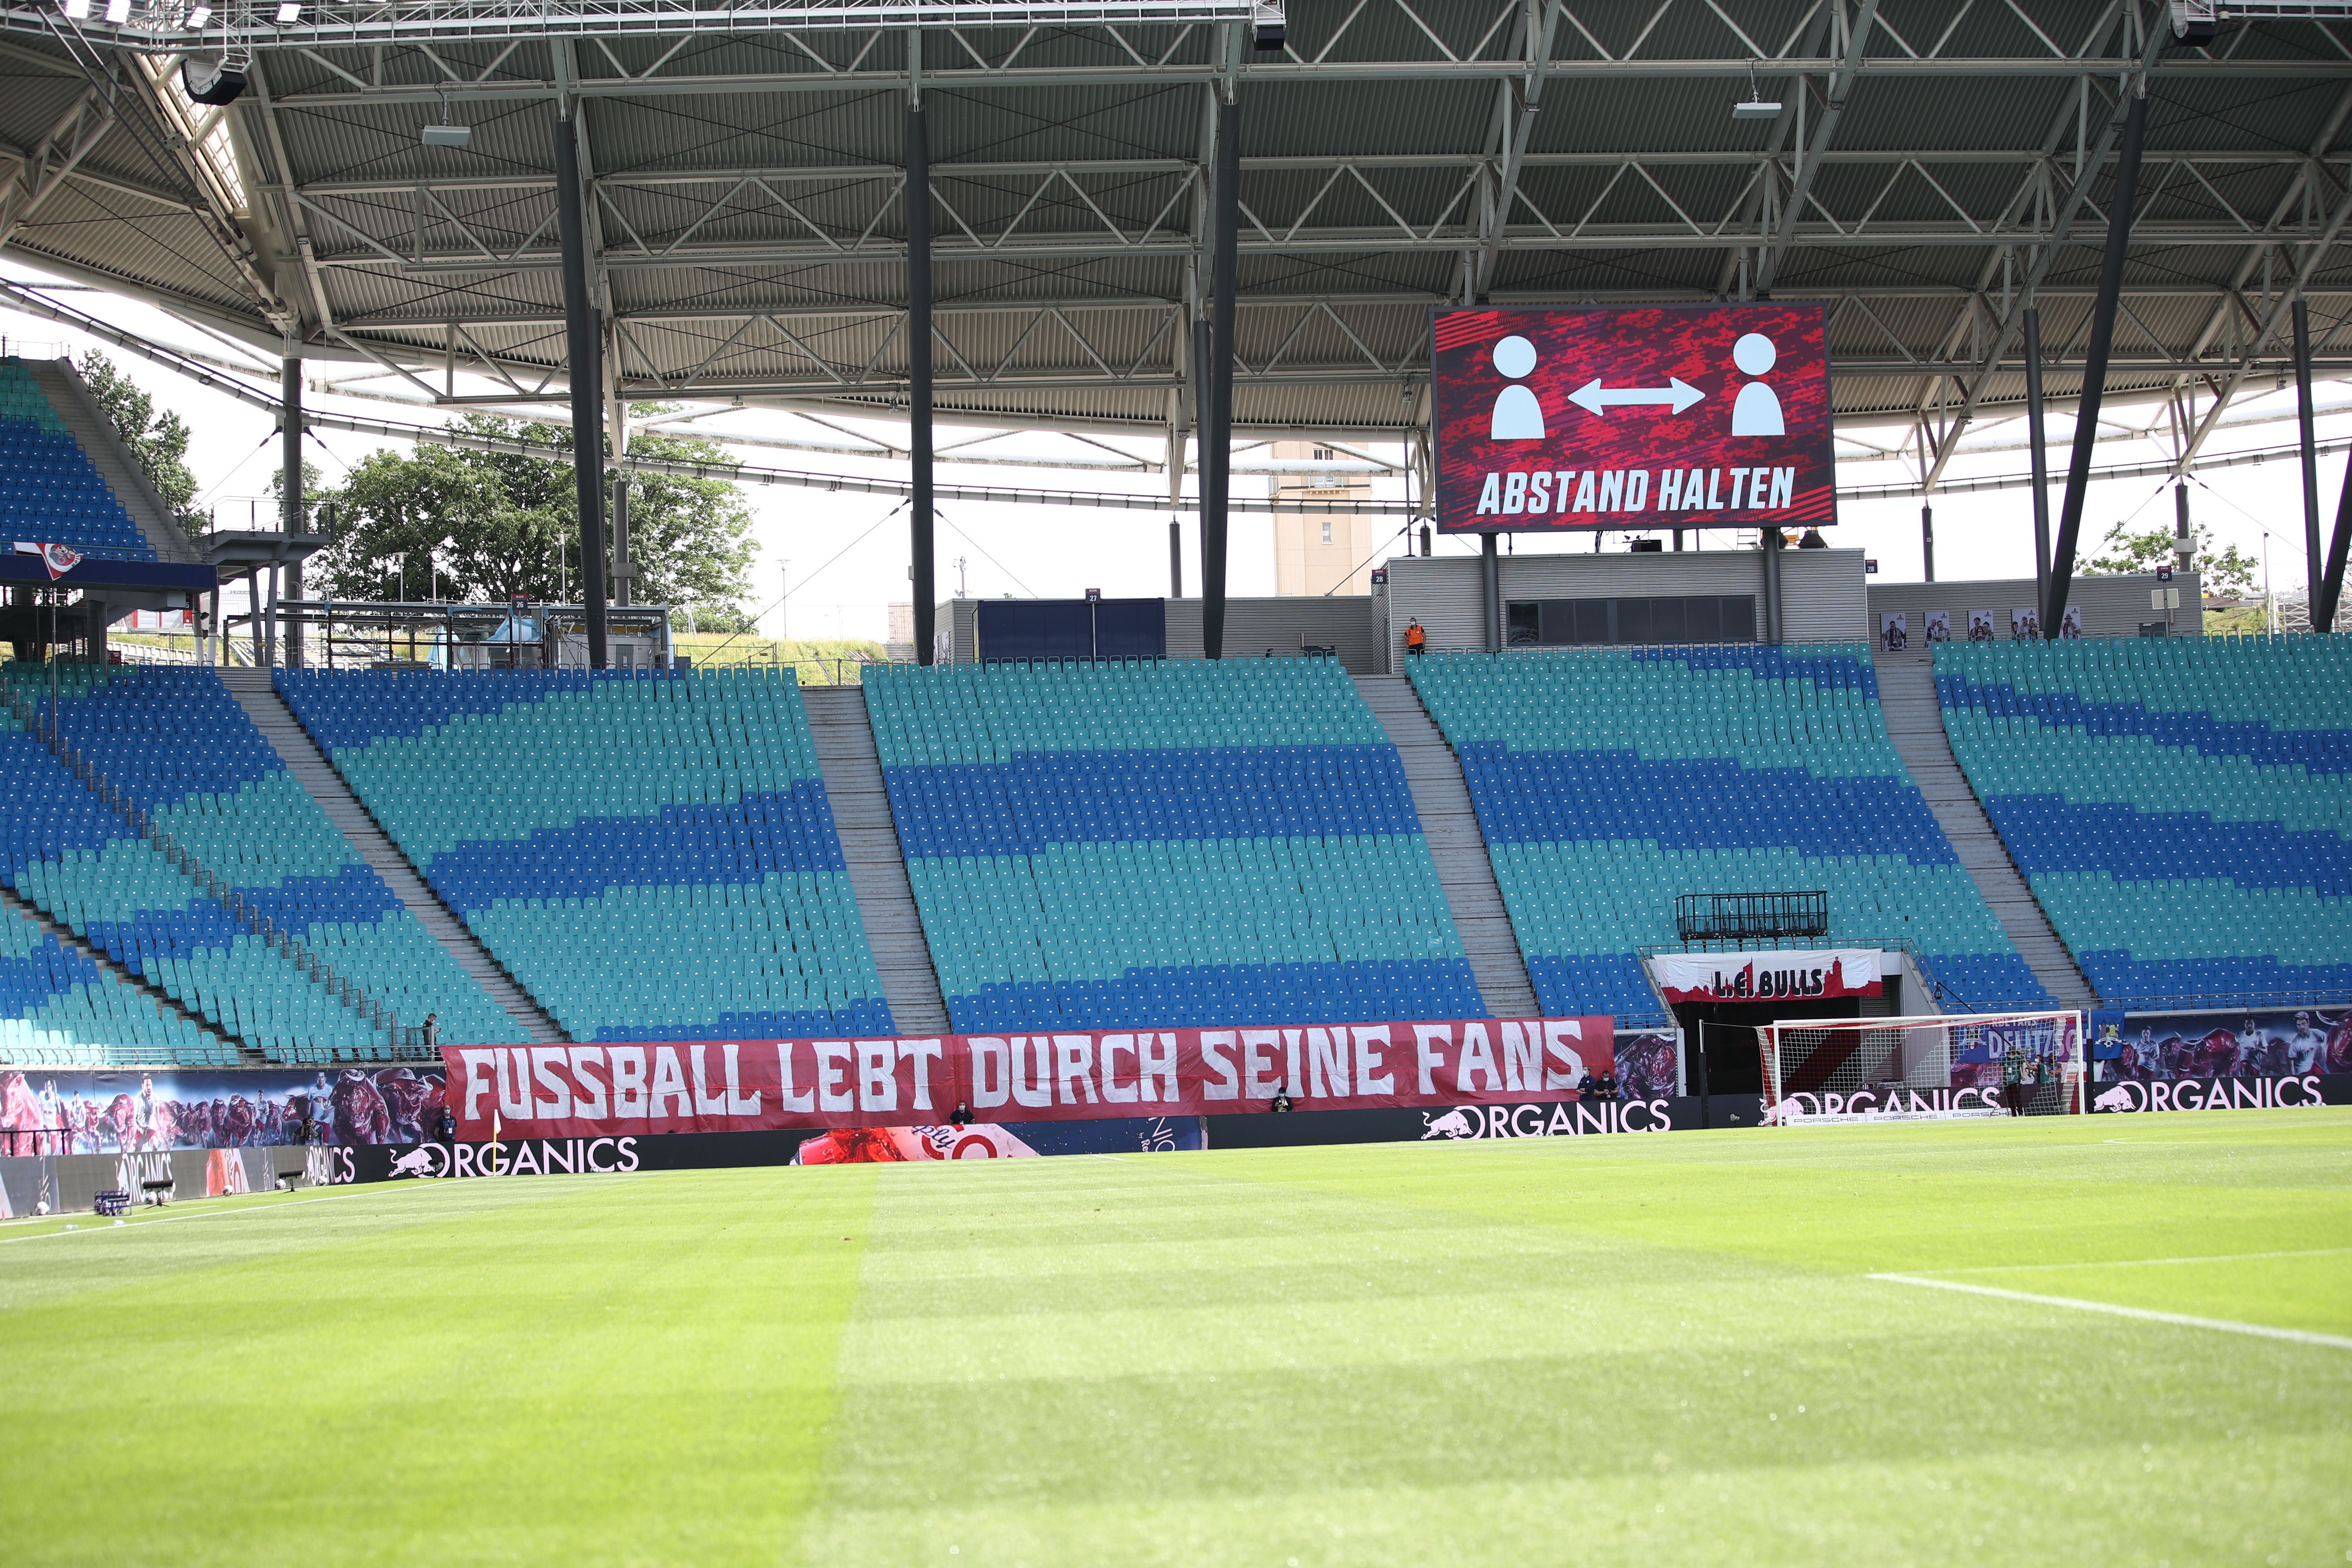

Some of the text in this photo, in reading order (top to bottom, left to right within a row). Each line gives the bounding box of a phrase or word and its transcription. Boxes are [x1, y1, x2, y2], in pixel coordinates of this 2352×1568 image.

[1476, 466, 1795, 514] ABSTAND HALTEN
[1760, 969, 1824, 998] BULLS
[459, 1020, 1582, 1120] FUSSBALL LEBT DURCH SEINE FANS
[1790, 1087, 2001, 1115] ORGANICS
[2118, 1075, 2322, 1112] ORGANICS
[1453, 1099, 1671, 1139] ORGANICS
[420, 1137, 639, 1178] ORGANICS
